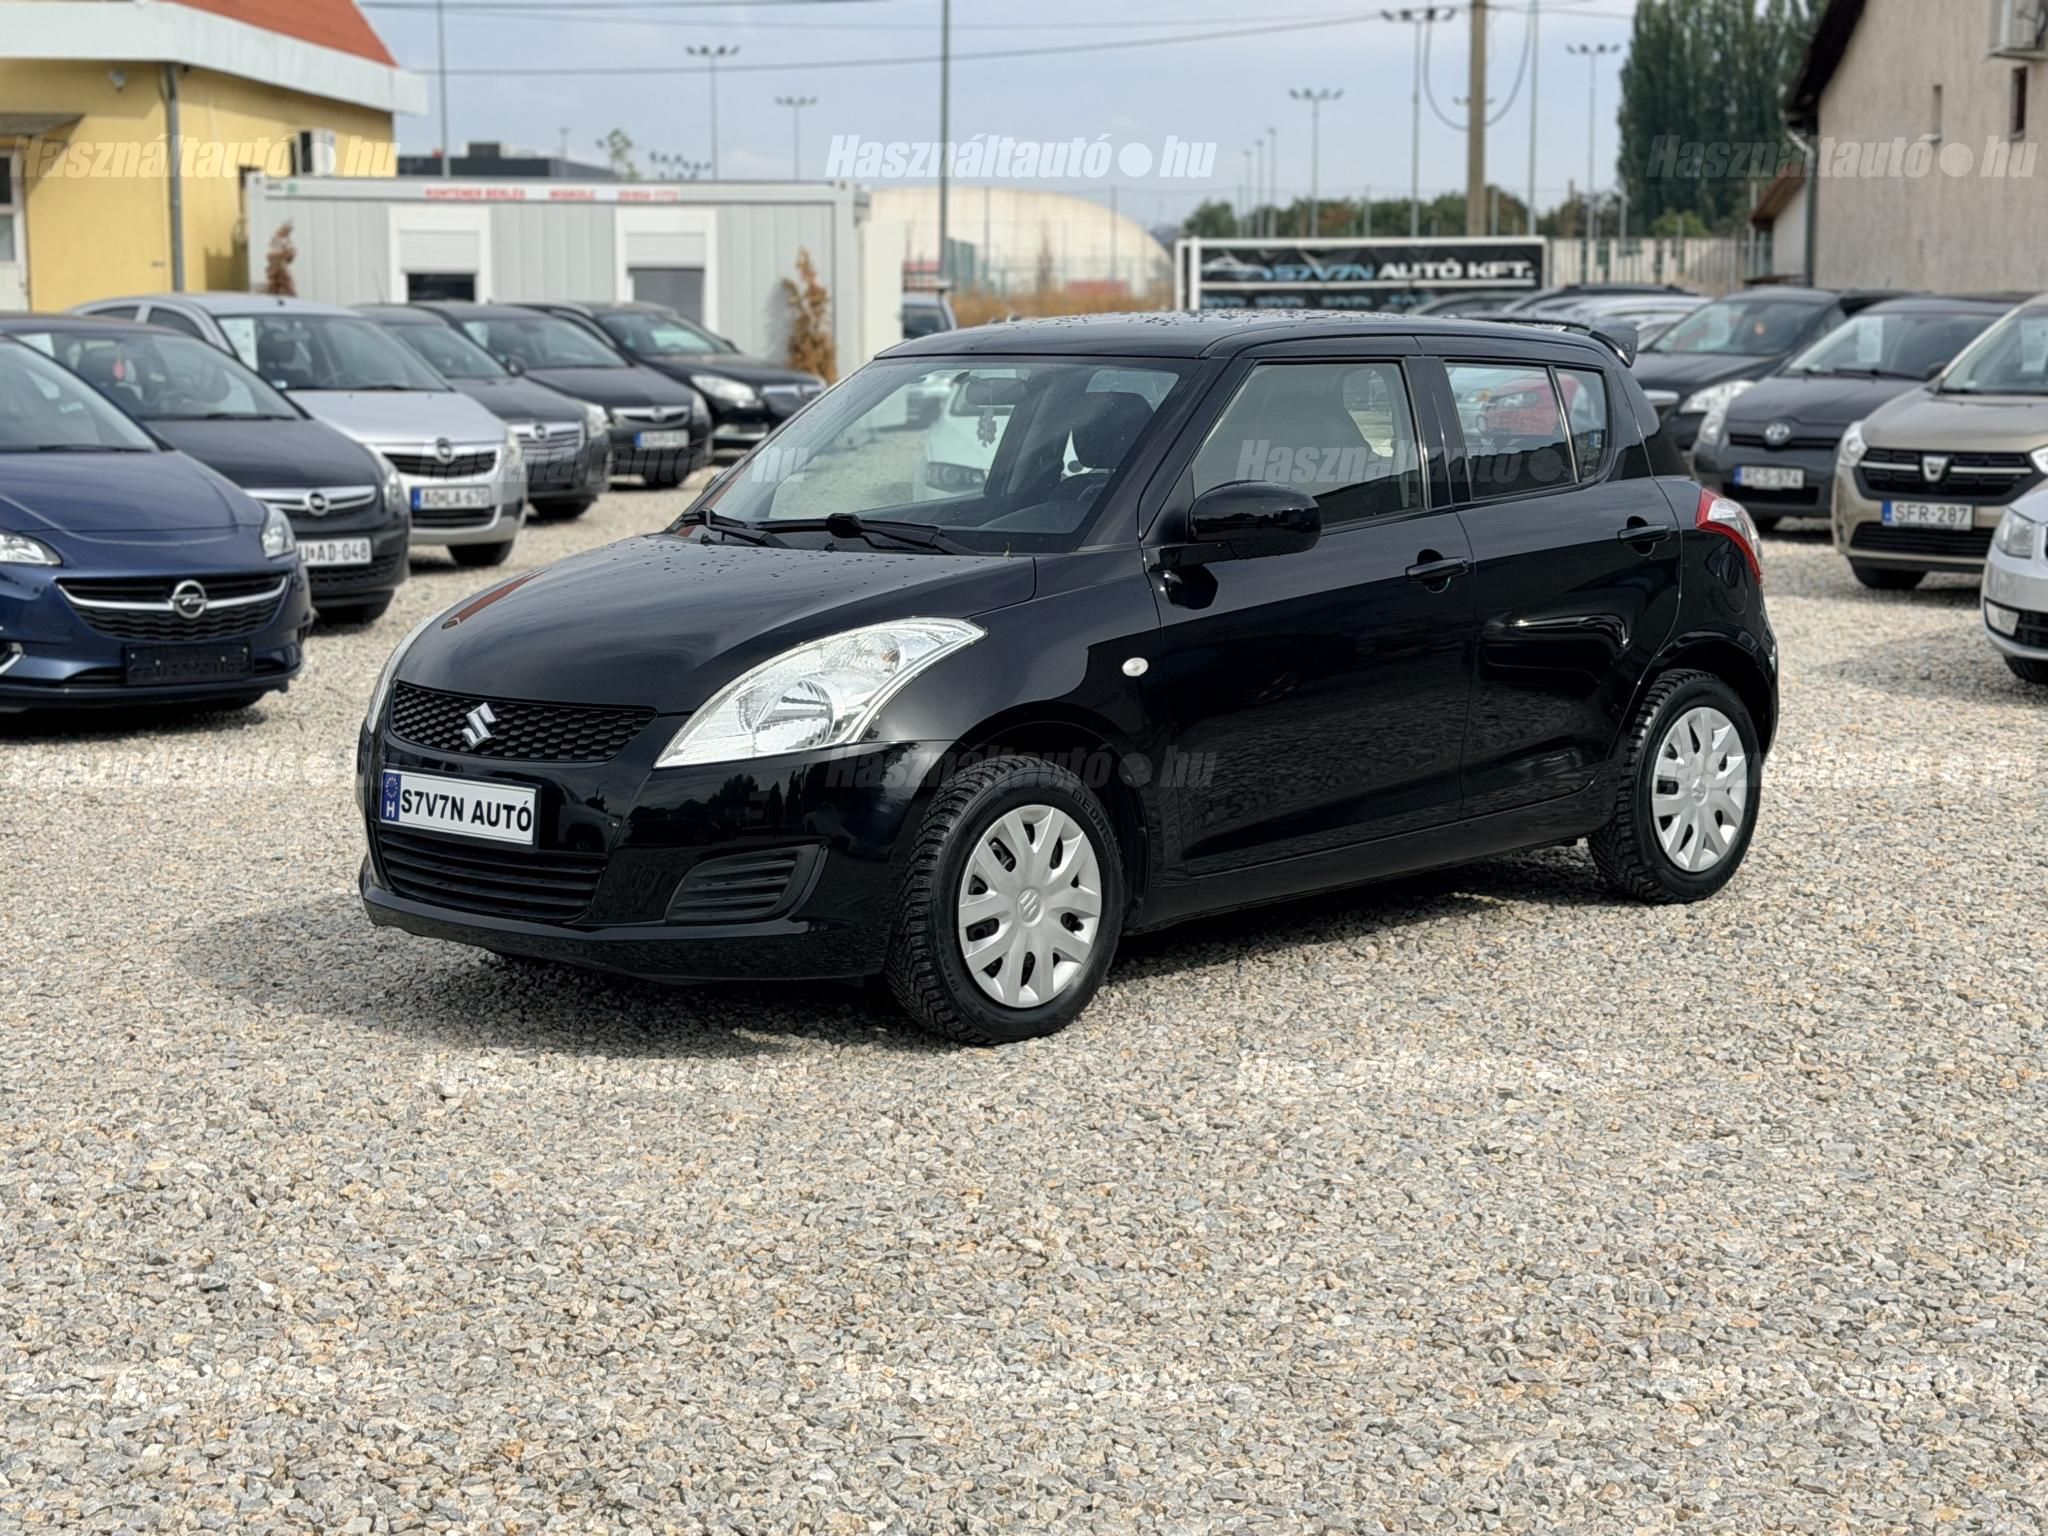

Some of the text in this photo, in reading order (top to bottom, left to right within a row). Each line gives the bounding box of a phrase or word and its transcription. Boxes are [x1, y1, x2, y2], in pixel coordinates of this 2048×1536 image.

[1378, 257, 1461, 279] AUTÓ
[1896, 504, 1968, 523] SFR-287
[400, 788, 464, 822] S7V7N
[470, 799, 532, 832] AUTÓ
